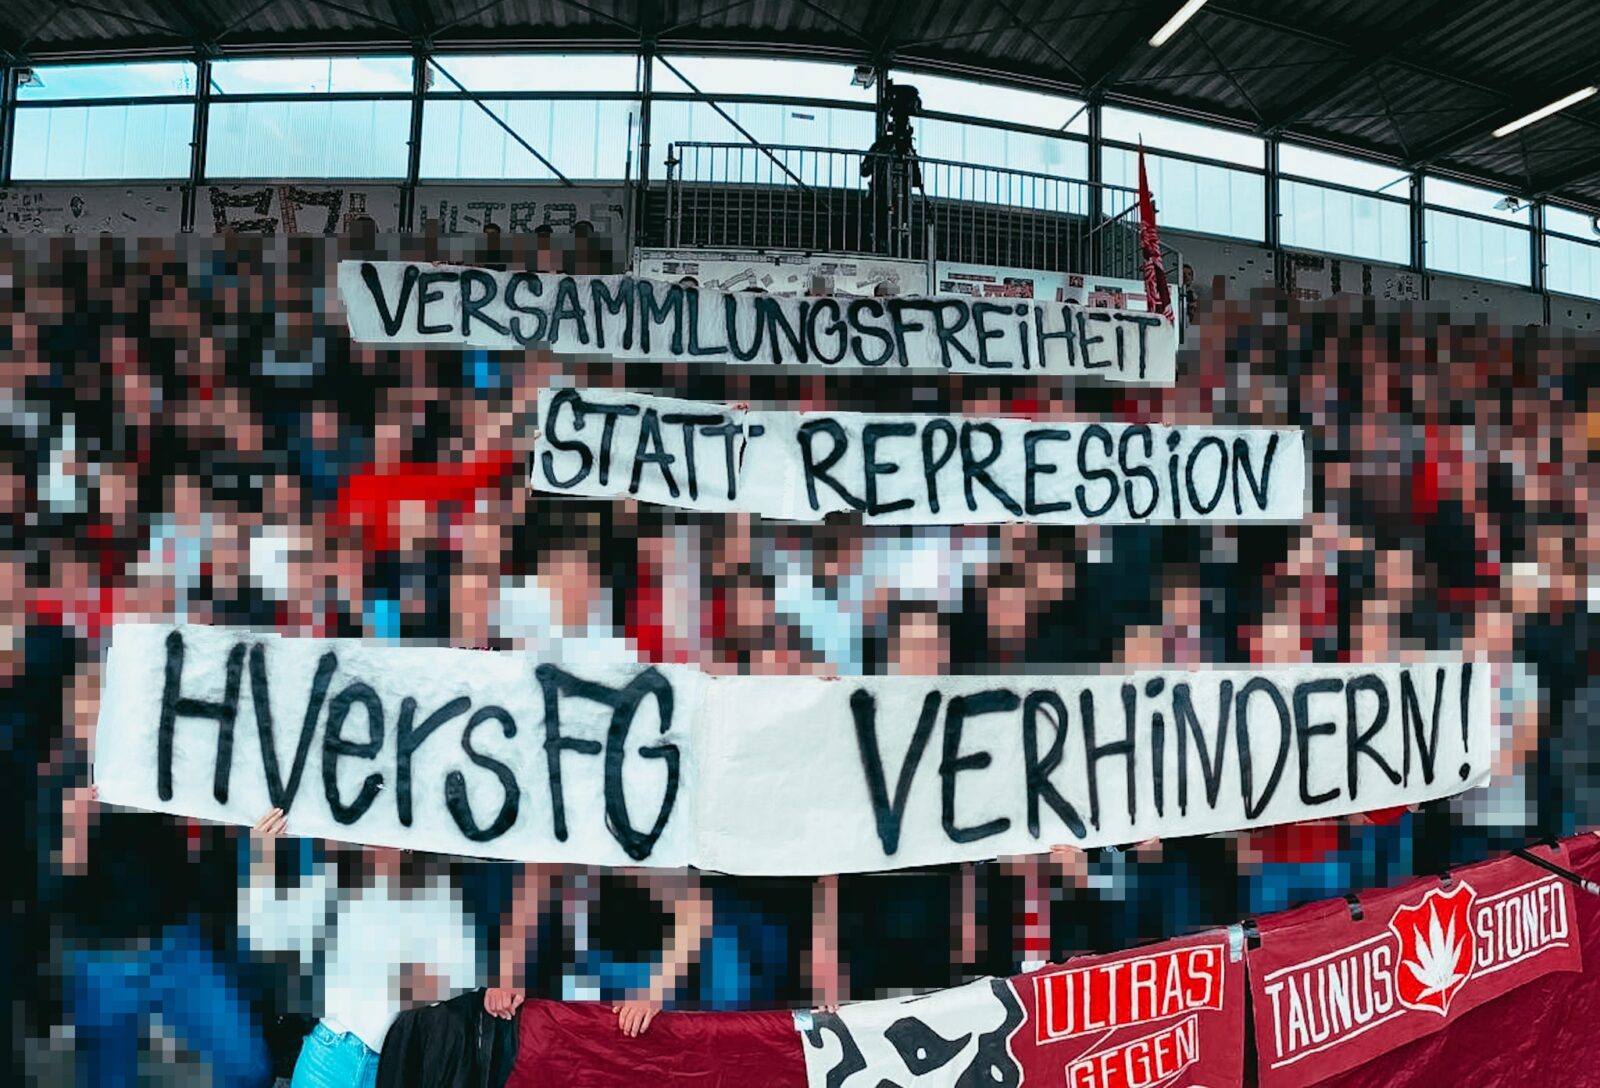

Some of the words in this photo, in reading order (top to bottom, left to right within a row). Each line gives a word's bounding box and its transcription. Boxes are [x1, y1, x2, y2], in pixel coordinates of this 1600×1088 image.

[541, 388, 764, 500] STATT
[157, 630, 681, 861] HVersFG
[1044, 950, 1214, 1037] ULTRAS
[1265, 944, 1394, 1057] TAUNUS
[1476, 881, 1569, 968] STONED
